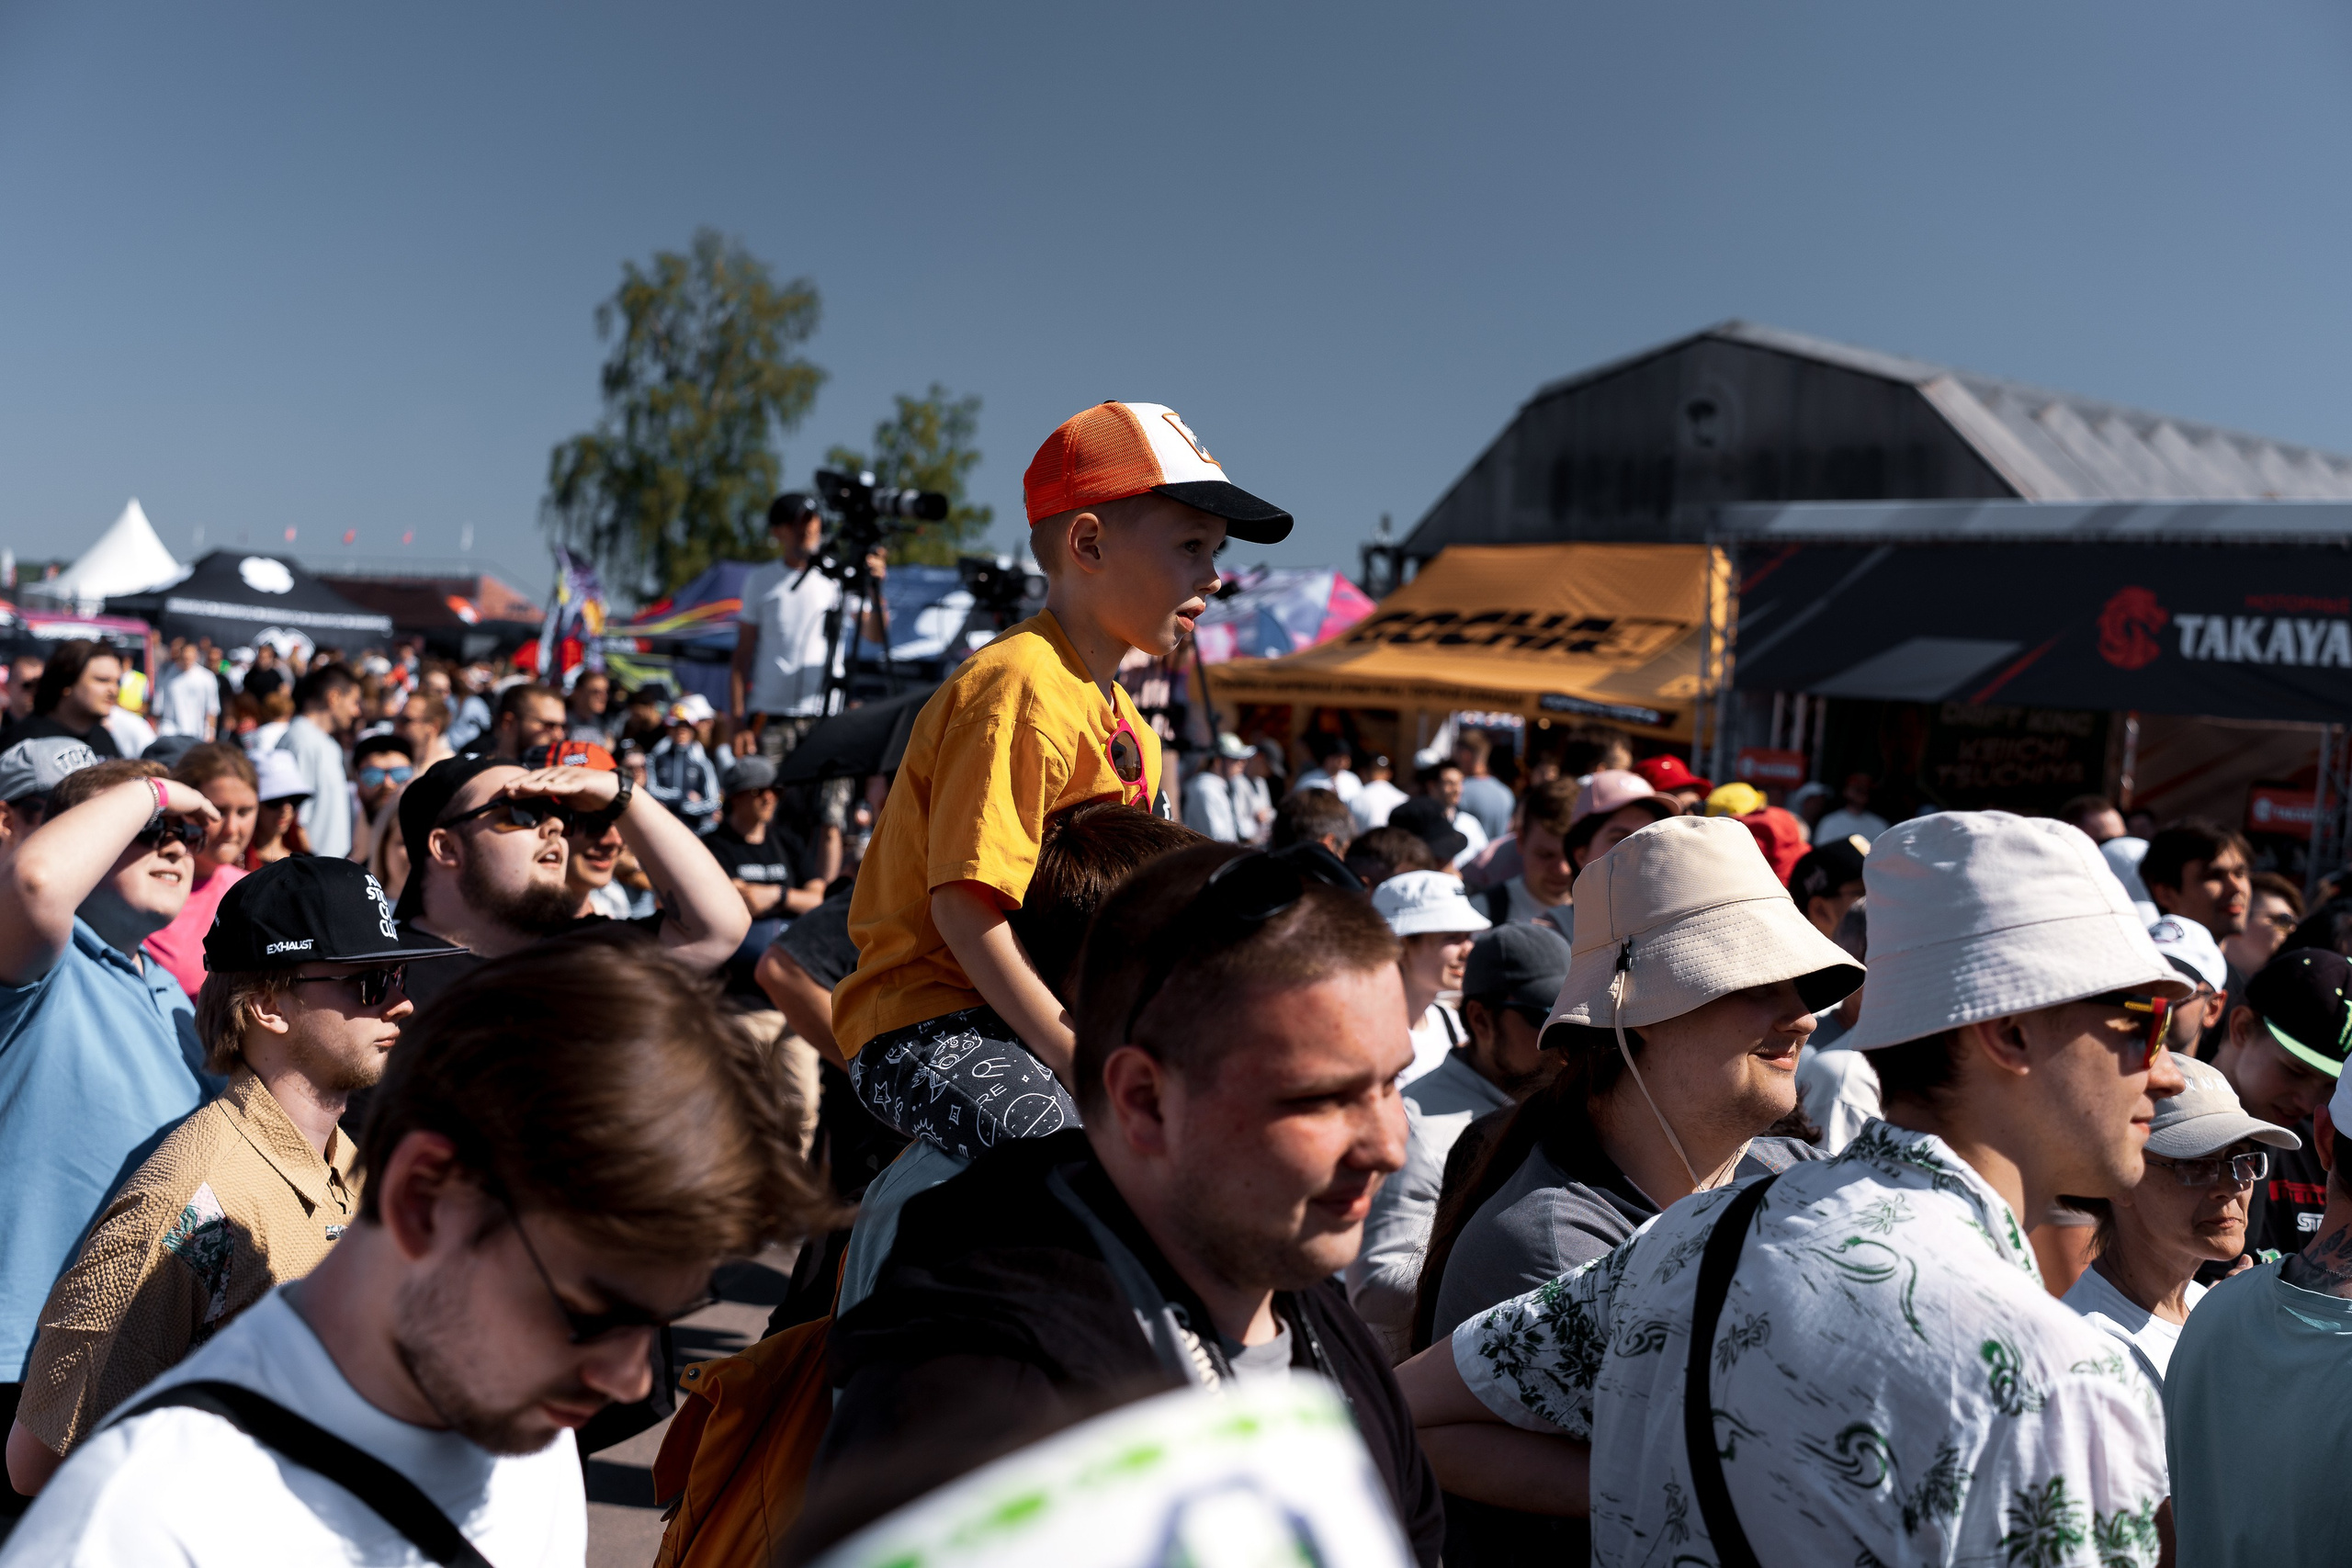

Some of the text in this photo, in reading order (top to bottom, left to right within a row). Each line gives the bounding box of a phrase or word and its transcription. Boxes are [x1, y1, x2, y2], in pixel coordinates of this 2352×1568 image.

[2173, 614, 2352, 669] TAKAYA
[53, 742, 98, 775] TOK
[266, 940, 314, 955] EXHAUST
